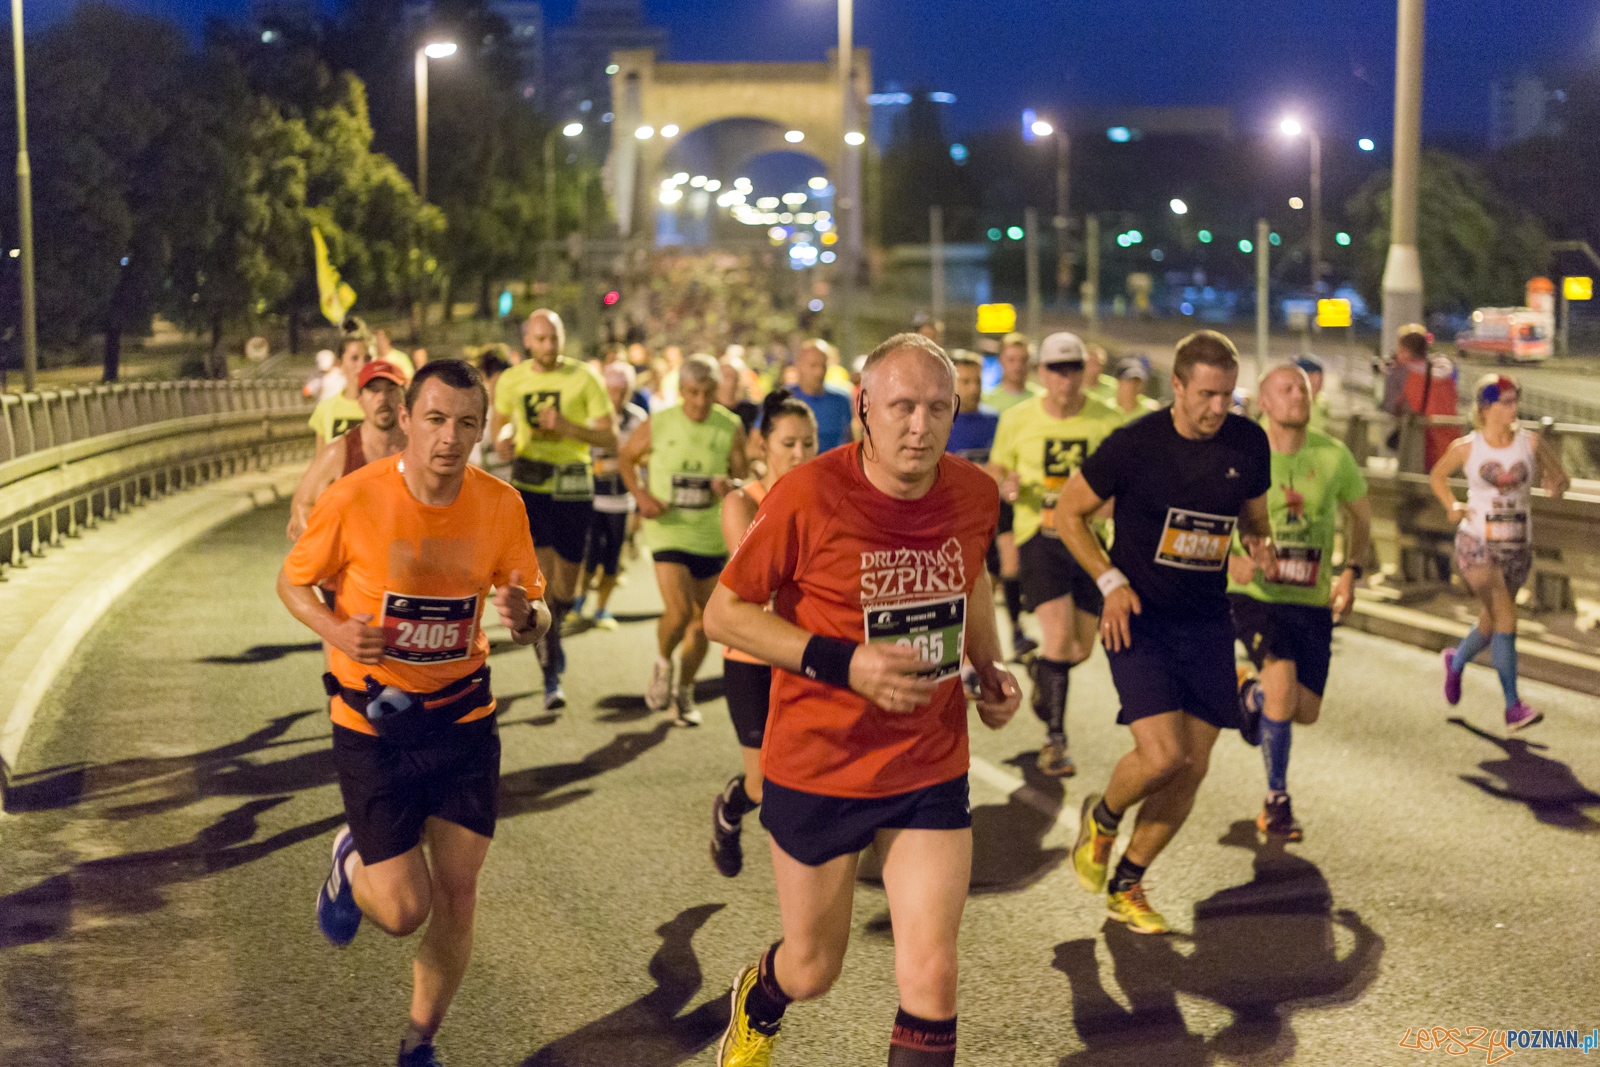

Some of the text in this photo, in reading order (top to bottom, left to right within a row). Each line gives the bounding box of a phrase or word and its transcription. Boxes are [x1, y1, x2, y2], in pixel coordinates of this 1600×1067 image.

[861, 547, 946, 570] DRUŻYNA
[860, 565, 965, 600] SZPIKU
[395, 622, 460, 649] 2405
